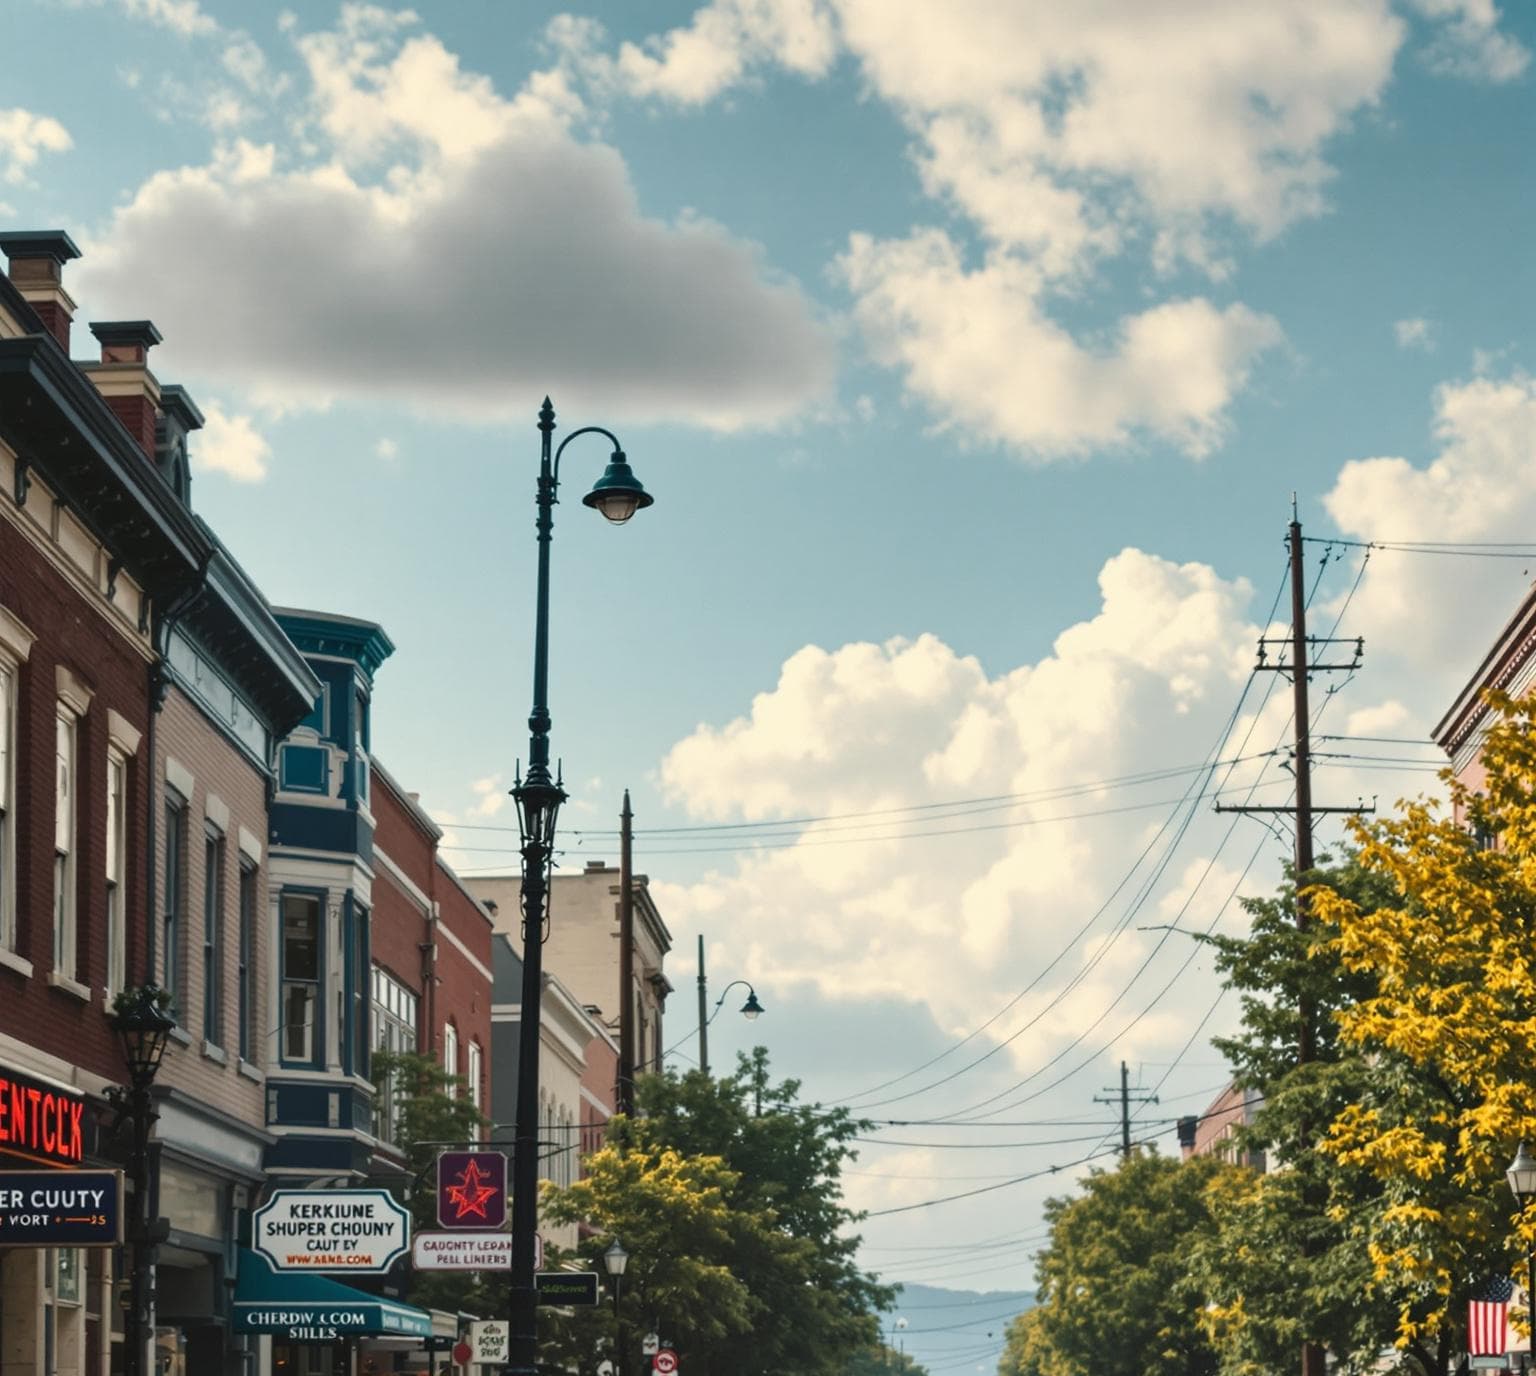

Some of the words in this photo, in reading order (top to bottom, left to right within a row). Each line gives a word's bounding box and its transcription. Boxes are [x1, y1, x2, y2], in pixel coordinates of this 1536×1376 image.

[31, 1190, 104, 1208] CUUTY
[267, 1222, 325, 1236] SHUPER
[331, 1222, 394, 1236] CHOUNY
